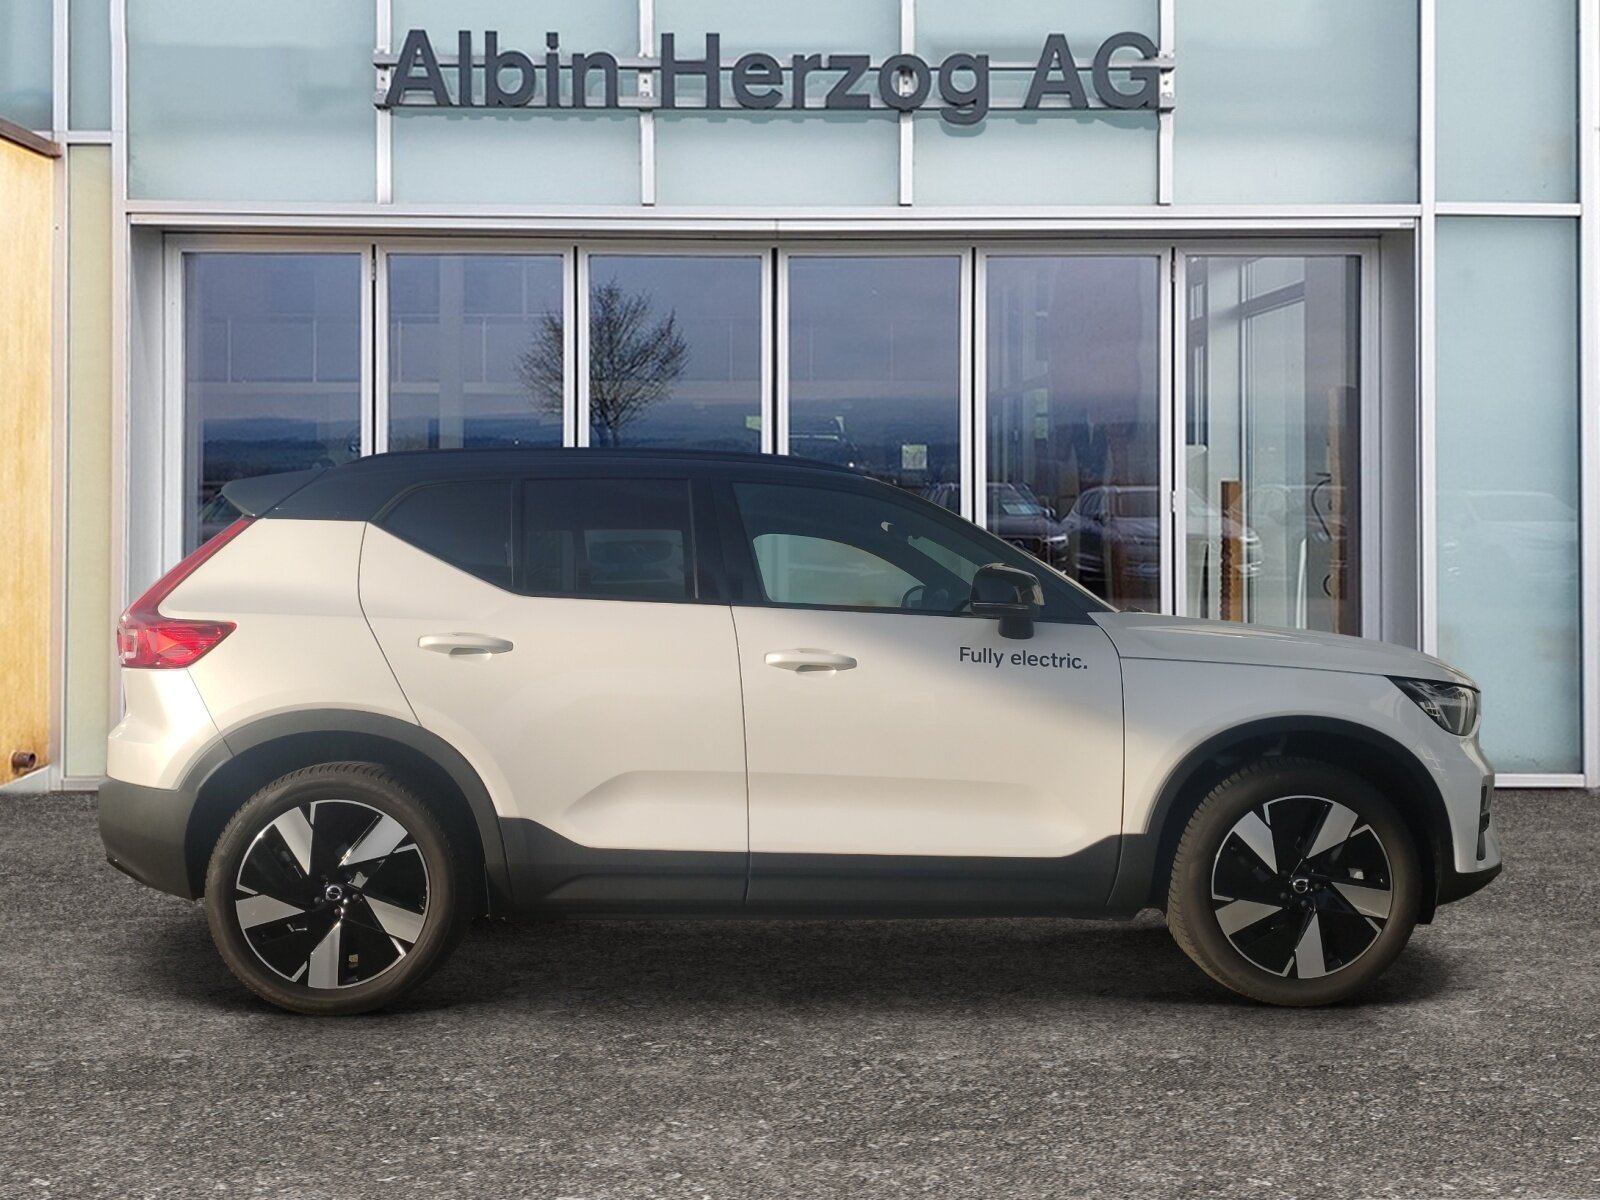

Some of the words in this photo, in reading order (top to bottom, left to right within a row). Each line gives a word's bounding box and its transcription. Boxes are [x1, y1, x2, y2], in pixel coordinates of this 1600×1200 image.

[386, 29, 619, 108] Albin
[661, 32, 990, 126] Herzog
[1022, 31, 1161, 110] AG
[959, 646, 1004, 668] Fully
[1010, 650, 1088, 670] electric.
